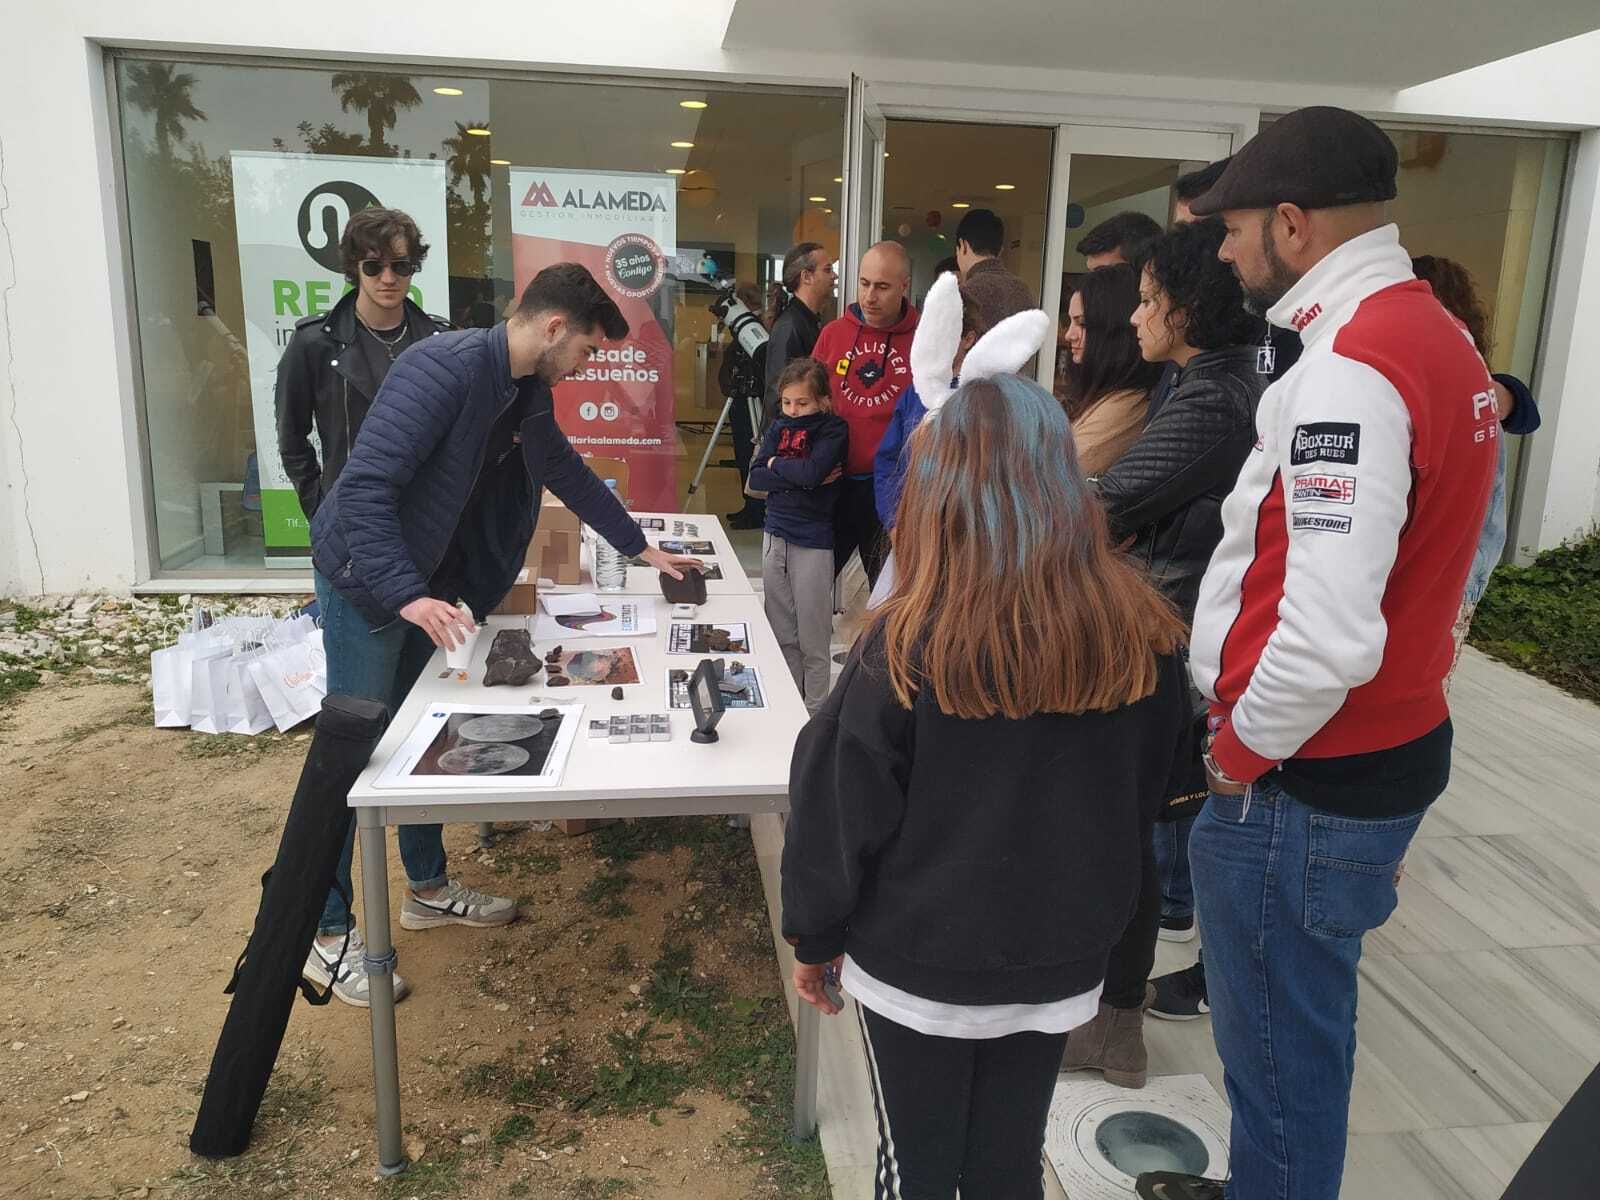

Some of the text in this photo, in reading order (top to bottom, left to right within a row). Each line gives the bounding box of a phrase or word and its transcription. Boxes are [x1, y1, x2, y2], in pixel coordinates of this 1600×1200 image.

[562, 189, 666, 212] ALAMEDA
[615, 254, 650, 269] 35 años
[618, 265, 653, 280] Contigo
[1300, 434, 1354, 450] BOXEUR
[1304, 448, 1346, 459] DES RUES
